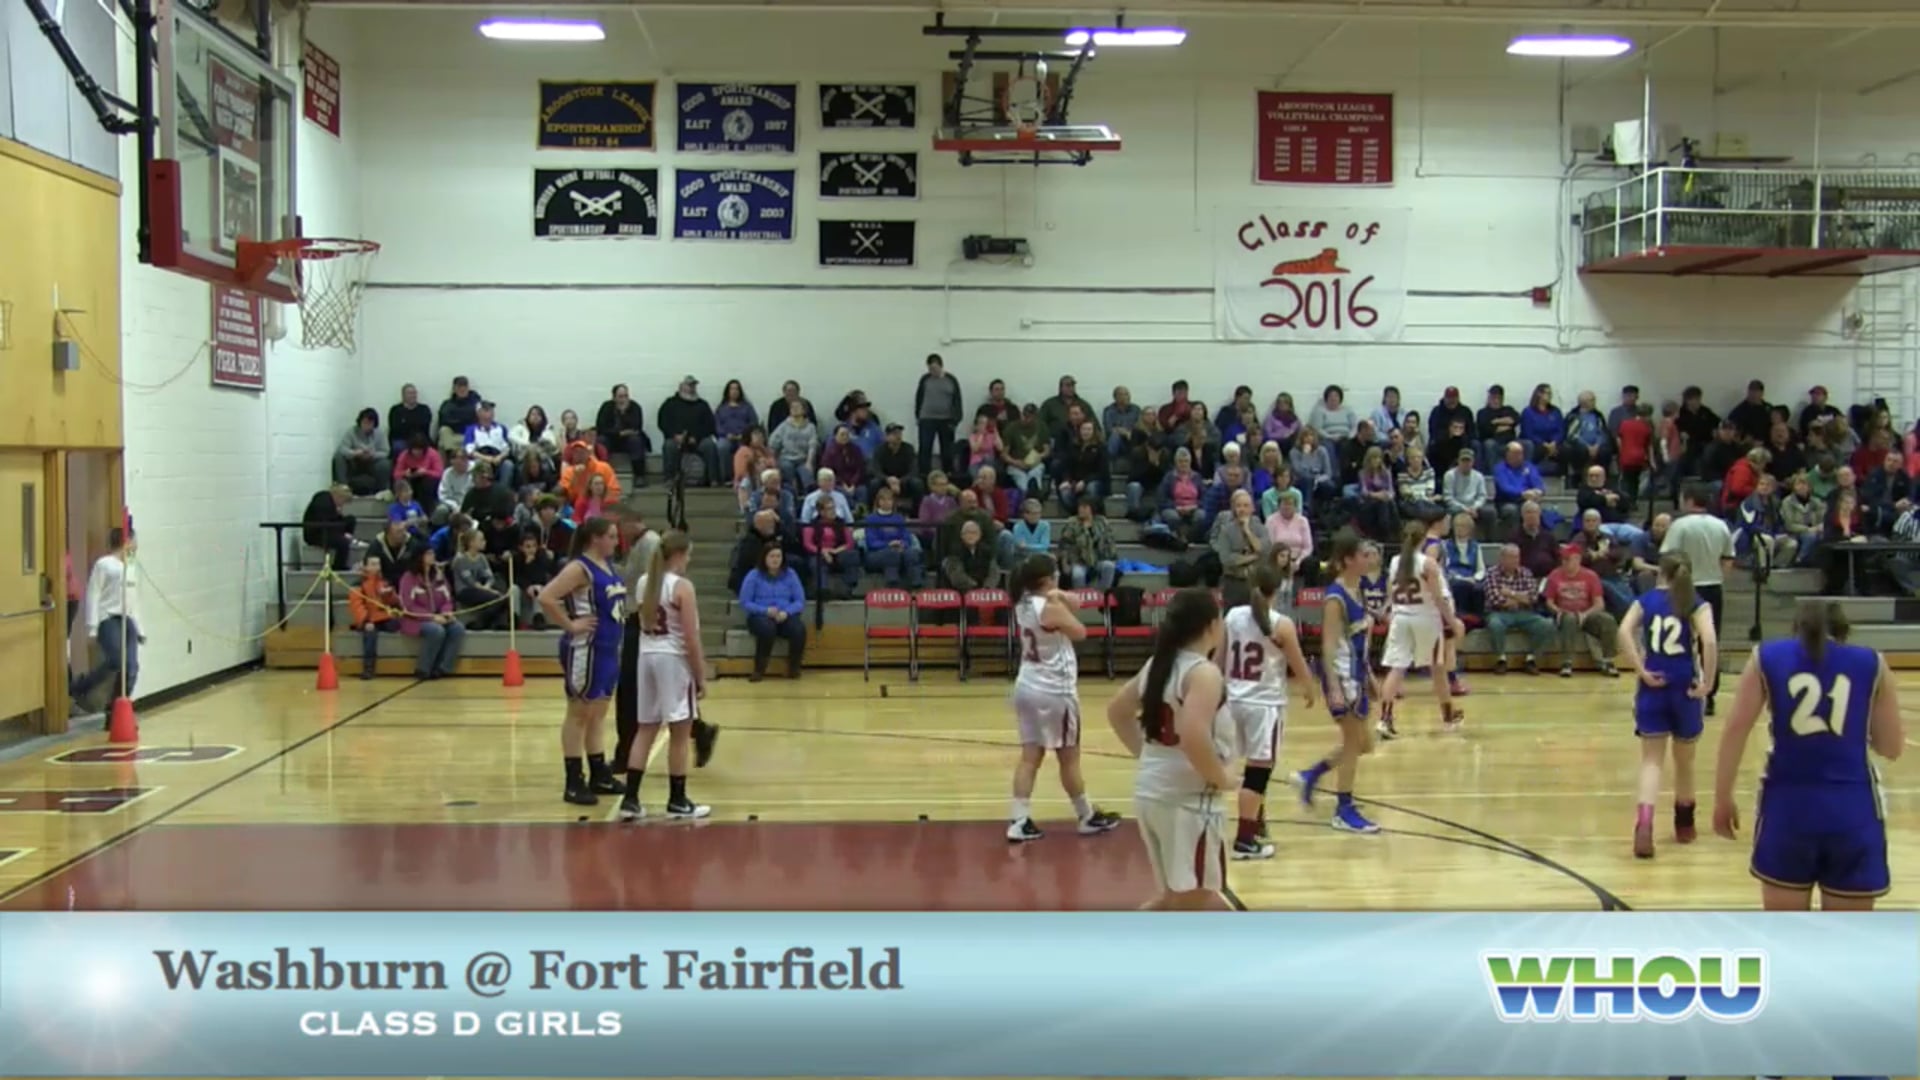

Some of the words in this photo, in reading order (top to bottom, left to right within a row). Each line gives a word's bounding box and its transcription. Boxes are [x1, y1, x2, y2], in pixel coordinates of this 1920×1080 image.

[681, 91, 706, 113] GOOD
[712, 84, 791, 110] SPORTSMANSHIP
[720, 95, 754, 106] AWARD
[546, 123, 645, 134] SPORTSMANSHIP
[684, 119, 711, 131] EAST
[679, 178, 705, 199] GOOD
[709, 170, 790, 198] SPORTSMANSHIP
[719, 182, 752, 193] AWARD
[682, 207, 708, 217] EAST
[1238, 213, 1329, 251] Class
[1345, 221, 1381, 246] of
[1259, 275, 1379, 330] 2016
[873, 592, 905, 601] TIGERS
[922, 592, 955, 601] TIGERS
[970, 592, 1003, 601] TIGERS
[1650, 614, 1686, 656] 12
[1228, 639, 1265, 681] 12
[1787, 671, 1851, 737] 21
